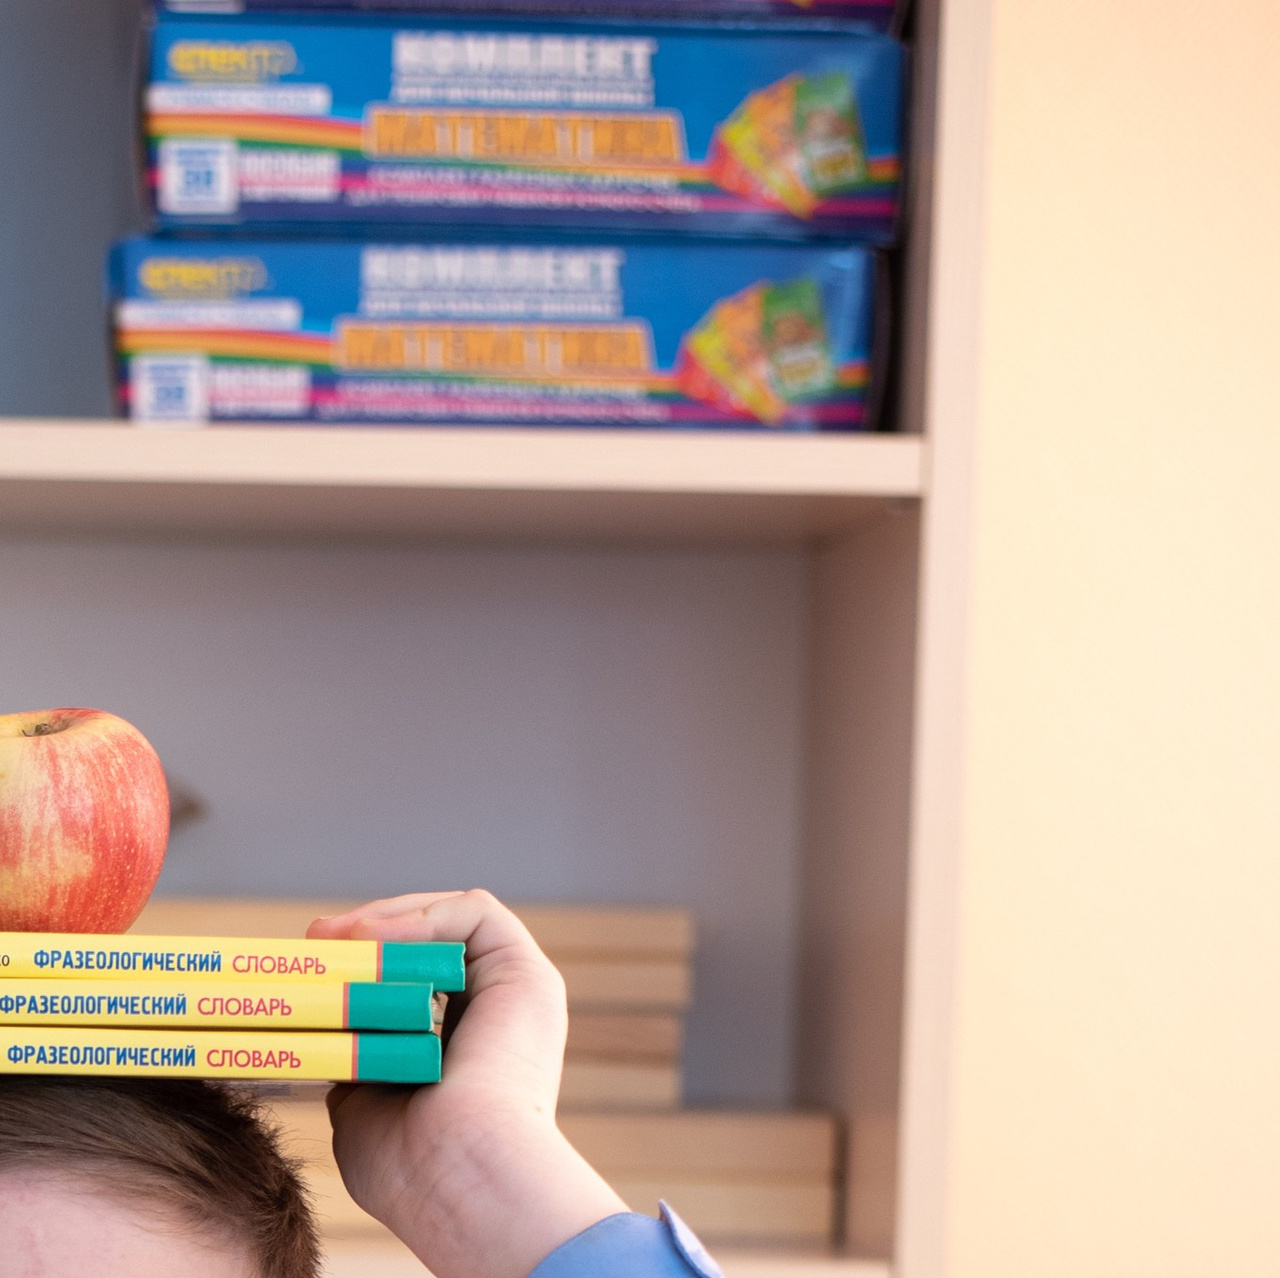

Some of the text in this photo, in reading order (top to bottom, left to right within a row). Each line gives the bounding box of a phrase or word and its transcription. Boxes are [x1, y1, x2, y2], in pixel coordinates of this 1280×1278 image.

[33, 949, 222, 973] ФРАЗЕОЛОГИЧЕСКИЙ
[232, 955, 326, 975] СЛОВАРЬ
[197, 997, 292, 1016] СЛОВАРЬ
[7, 1044, 196, 1067] ФРАЗЕОЛОГИЧЕСКИЙ
[206, 1049, 301, 1069] СЛОВАРЬ
